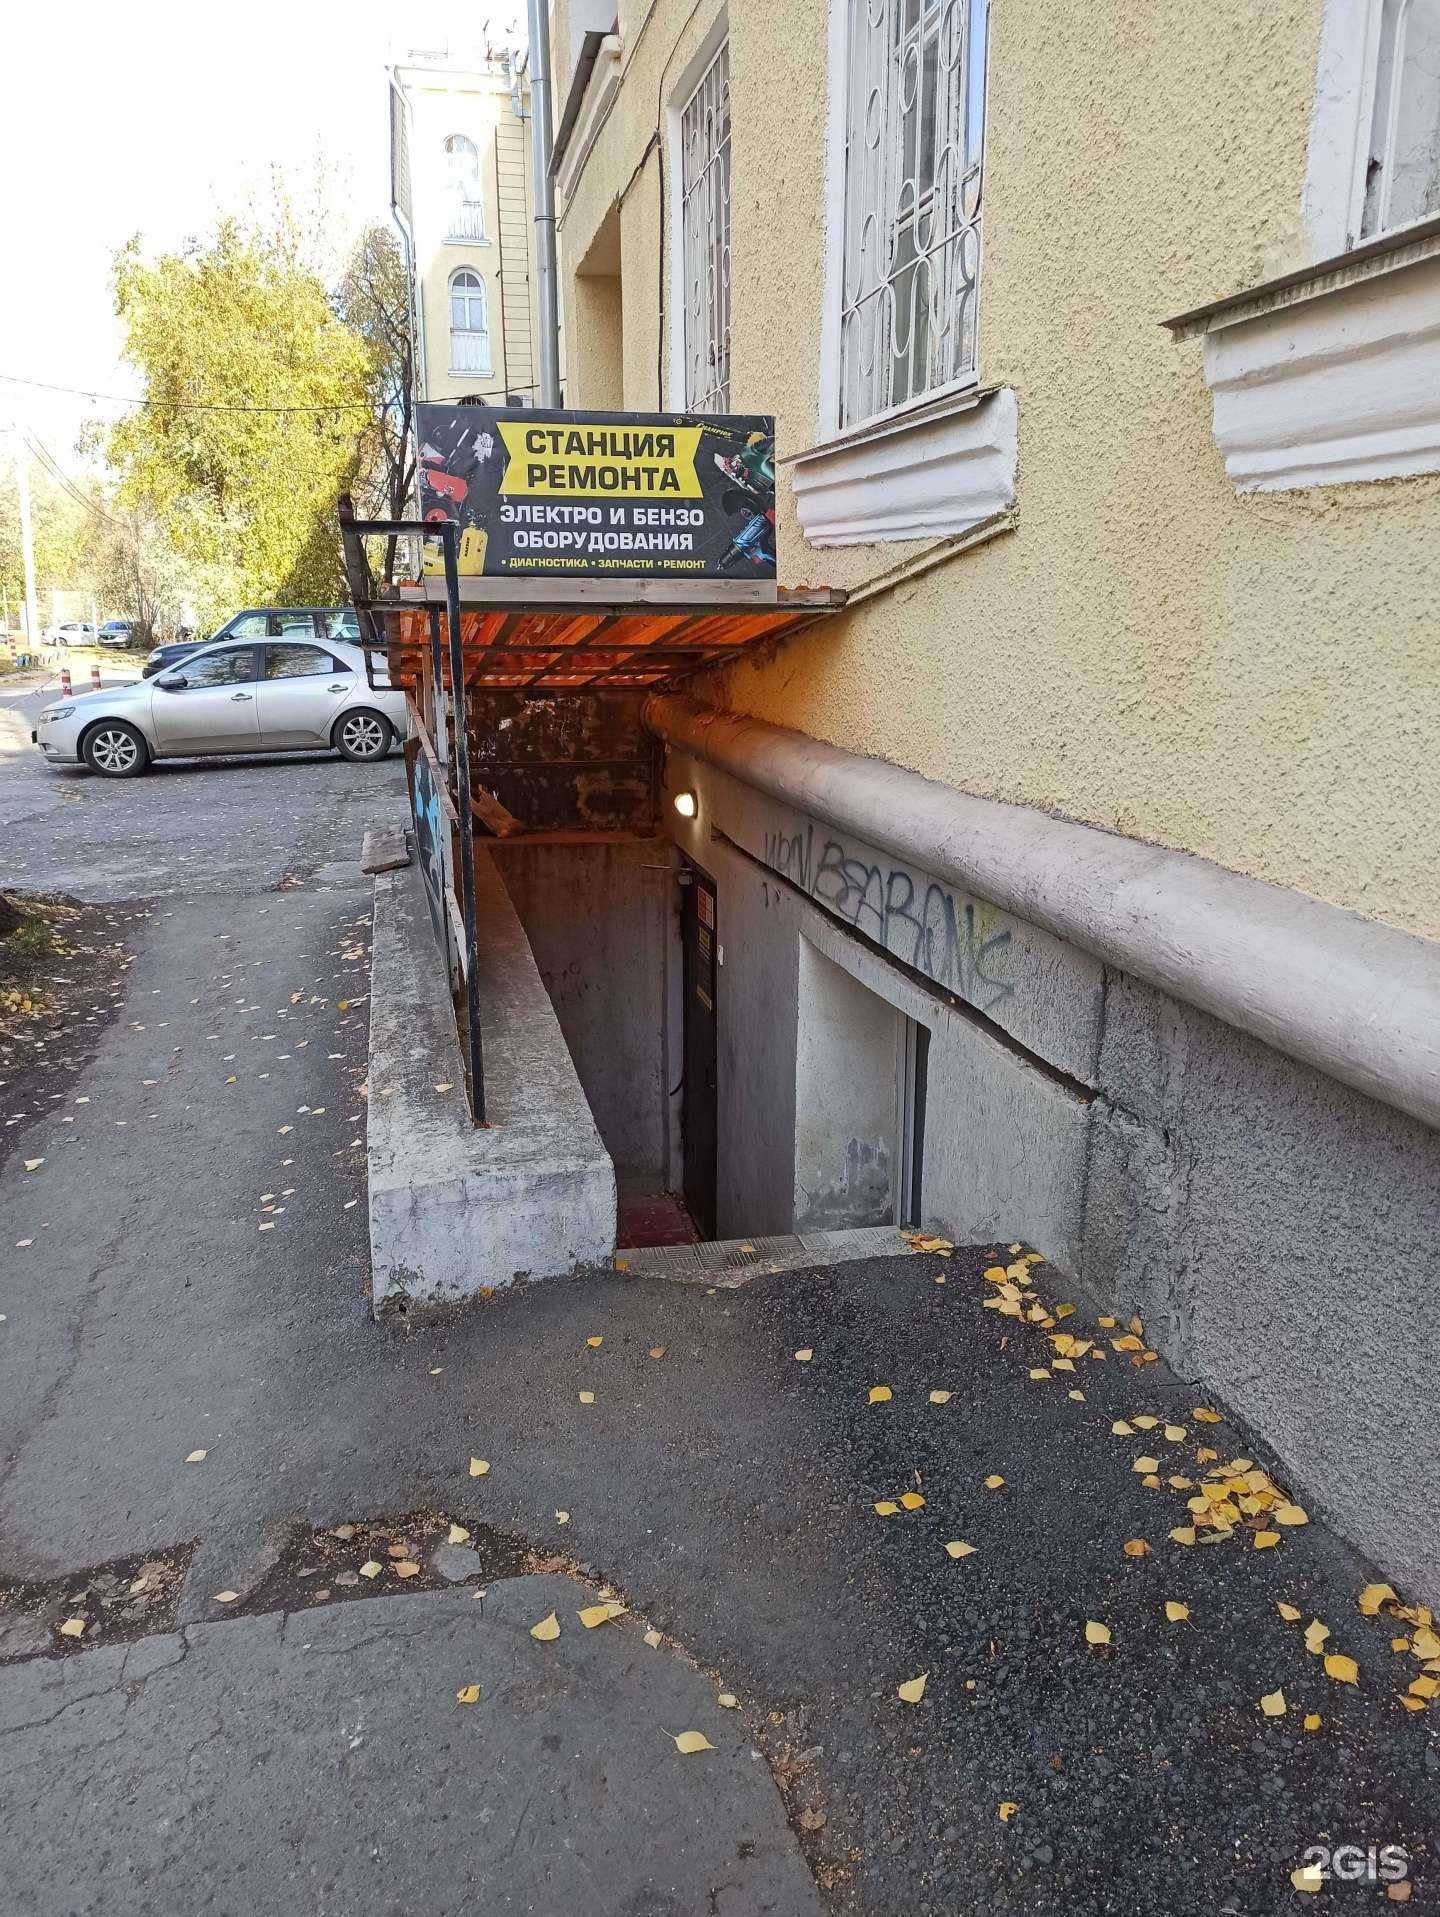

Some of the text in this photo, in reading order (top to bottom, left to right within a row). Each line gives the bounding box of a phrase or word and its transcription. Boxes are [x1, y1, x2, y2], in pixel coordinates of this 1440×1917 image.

[525, 428, 675, 460] СТАНЦИЯ
[527, 463, 681, 492] РЕМОНТА
[499, 504, 705, 527] ЭЛЕКТРО И БЕНЗО
[513, 530, 693, 552] ОБОРУДОВАНИЯ
[509, 557, 707, 570] ДИАГНОСТИКА ЗАПЧАСТИ РЕМОНТ
